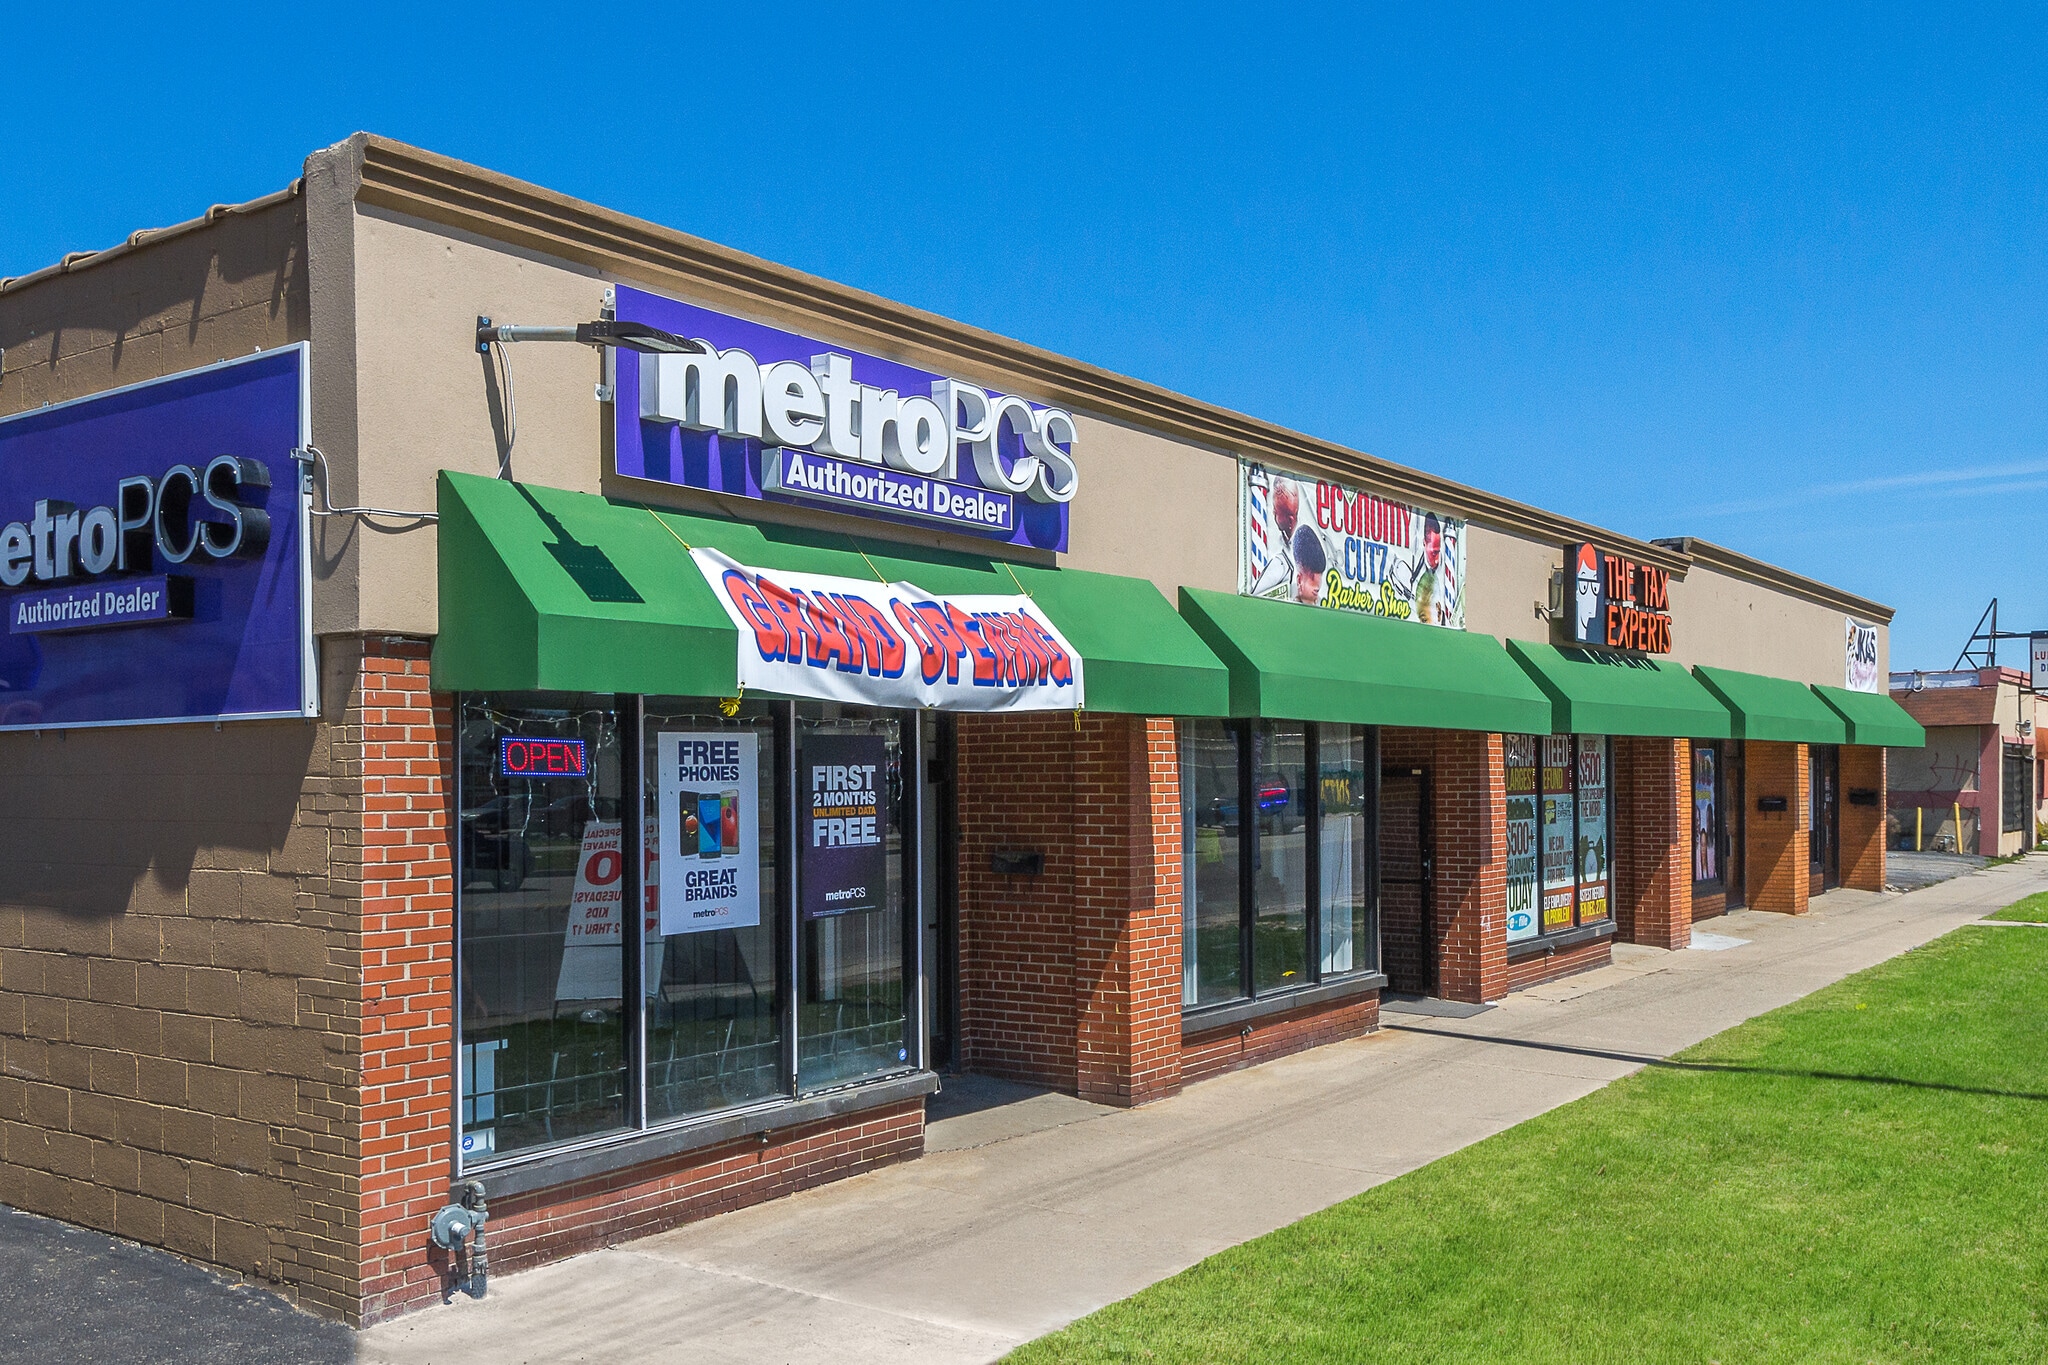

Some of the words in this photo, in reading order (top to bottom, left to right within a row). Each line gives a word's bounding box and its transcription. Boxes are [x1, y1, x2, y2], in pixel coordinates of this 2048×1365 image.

[640, 338, 1079, 504] metroPCS
[786, 453, 929, 511] Authorized
[933, 484, 1008, 527] Dealer
[0, 454, 258, 587] etroPCS
[1344, 537, 1389, 585] CUTZ
[1322, 568, 1374, 610] Barber
[1375, 580, 1411, 620] Shop
[1604, 555, 1636, 602] THE
[1642, 565, 1670, 611] TAX
[17, 592, 100, 625] Authorized
[104, 586, 160, 615] Dealer
[722, 569, 907, 680] GRAND
[889, 597, 1074, 688] OPENING
[1607, 605, 1672, 654] EXPERTS
[2035, 651, 2048, 660] LU
[506, 741, 583, 773] OPEN
[678, 740, 740, 765] FREE
[678, 765, 740, 782] PHONES
[812, 764, 876, 792] FIRST
[1543, 767, 1563, 790] EFUND
[1580, 751, 1601, 788] $500
[813, 792, 822, 807] 2
[824, 790, 877, 807] MONTHS
[813, 807, 856, 818] UNLIMITED
[858, 806, 876, 815] DATA
[813, 816, 881, 847] FREE.
[685, 868, 738, 888] GREAT
[685, 885, 738, 902] BRANDS
[825, 887, 866, 901] metroPCS
[693, 906, 729, 919] metroPCS
